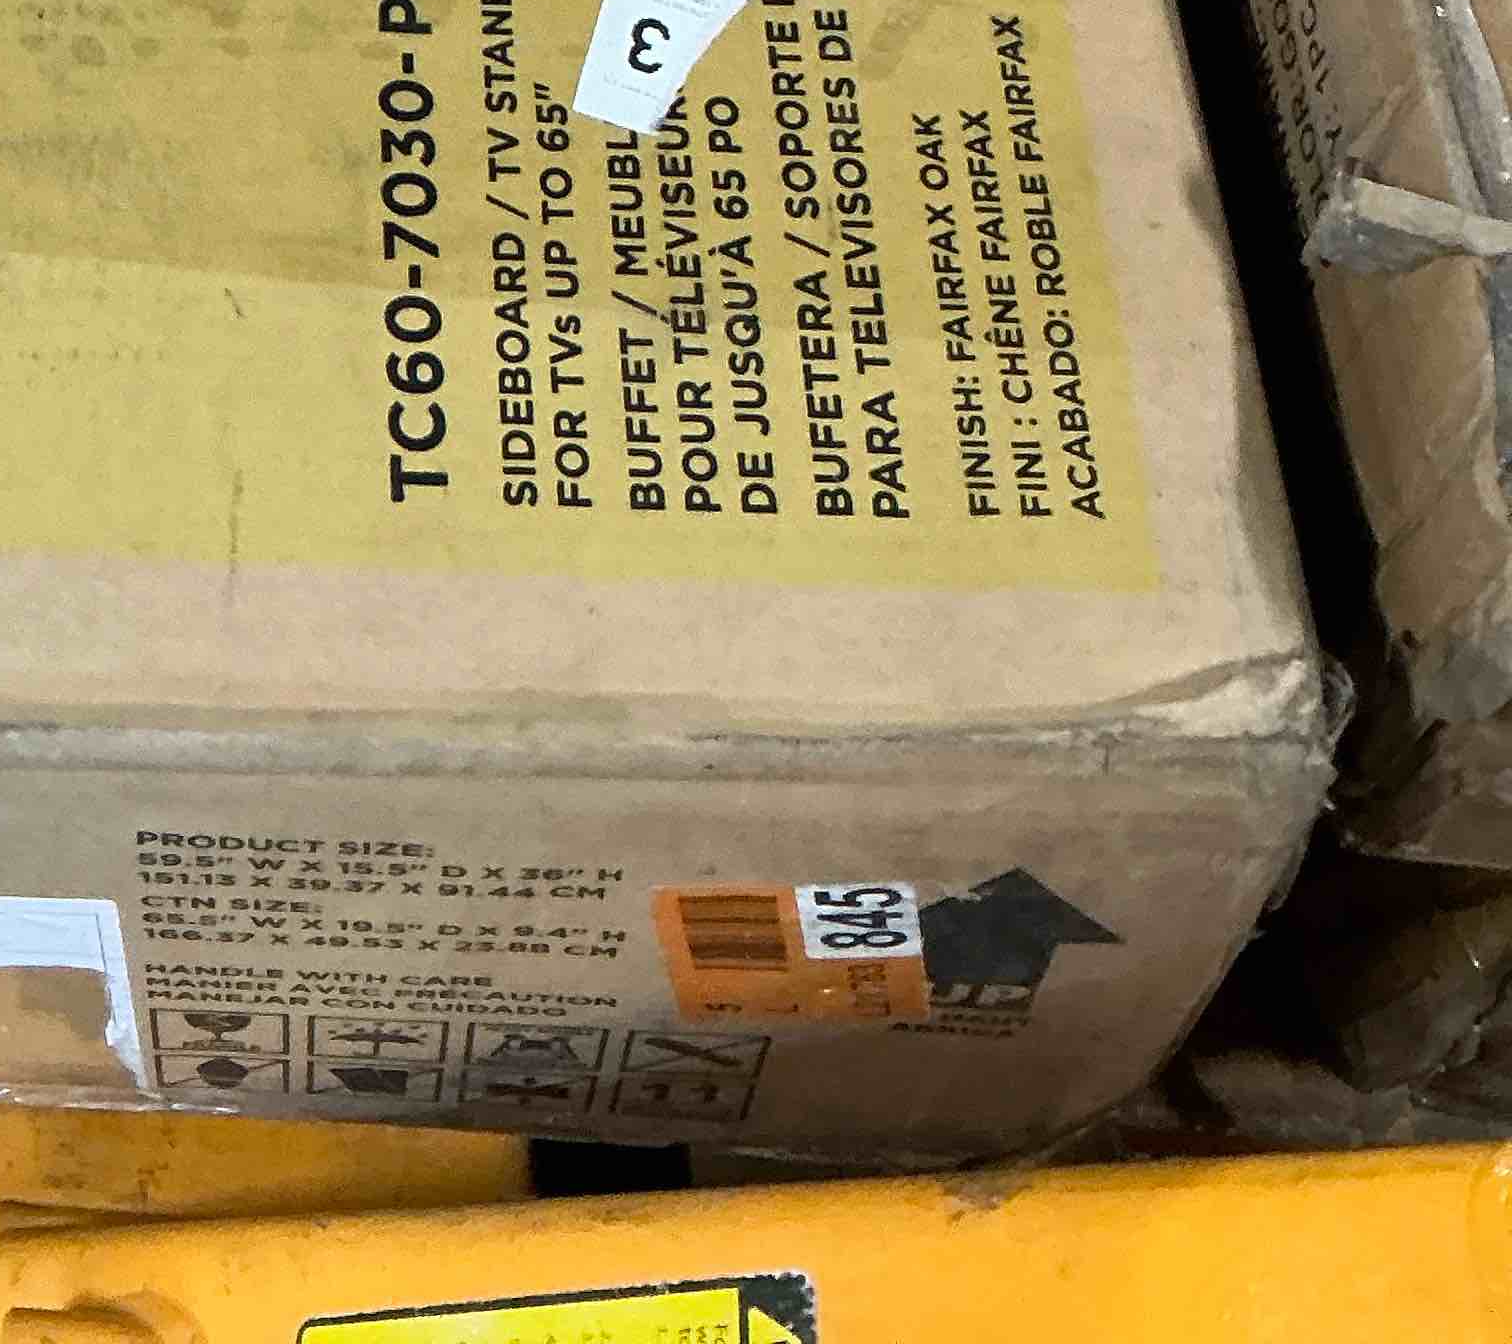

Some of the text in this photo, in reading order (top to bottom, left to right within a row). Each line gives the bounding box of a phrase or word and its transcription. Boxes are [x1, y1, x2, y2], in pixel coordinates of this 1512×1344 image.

[629, 19, 670, 74] 3
[814, 9, 852, 62] DE
[765, 20, 820, 220] SOPORTE
[487, 128, 521, 182] TV
[486, 195, 529, 220] /
[540, 167, 573, 226] TO
[606, 130, 648, 276] MEUBL
[960, 110, 1011, 262] FAIRFAX
[784, 232, 831, 258] /
[824, 77, 891, 375] TELEVISORES
[544, 239, 579, 298] UP
[992, 15, 1104, 519] ACABADO: ROBLE FAIRFAX
[612, 290, 657, 317] /
[656, 90, 721, 513] POUR TÉLÉVISEUR
[705, 96, 778, 515] DE JUSQU'À 65 PO
[913, 114, 1000, 516] FINISH: FAIRFAX OAK
[492, 232, 539, 507] SIDEBOARD
[549, 315, 585, 394] TVs
[985, 275, 1033, 404] CHÊNE
[619, 327, 665, 511] BUFFET
[794, 270, 854, 517] BUFETERA
[554, 410, 593, 508] FOR
[862, 391, 910, 519] PARA
[1010, 441, 1052, 517] FINI
[137, 831, 434, 858] PRODUCT SIZE:
[248, 857, 286, 871] W
[440, 865, 467, 878] D
[597, 868, 623, 882] H
[141, 895, 323, 914] CTN SIZE:
[549, 886, 606, 901] CM
[815, 887, 908, 950] 845
[250, 916, 287, 929] W
[437, 924, 462, 936] D
[603, 930, 626, 943] H
[564, 945, 617, 958] CM
[145, 963, 492, 987] HANDLE WITH CARE
[145, 990, 568, 1017] MANEJAR CON CUIDADO
[289, 983, 380, 997] AVEC
